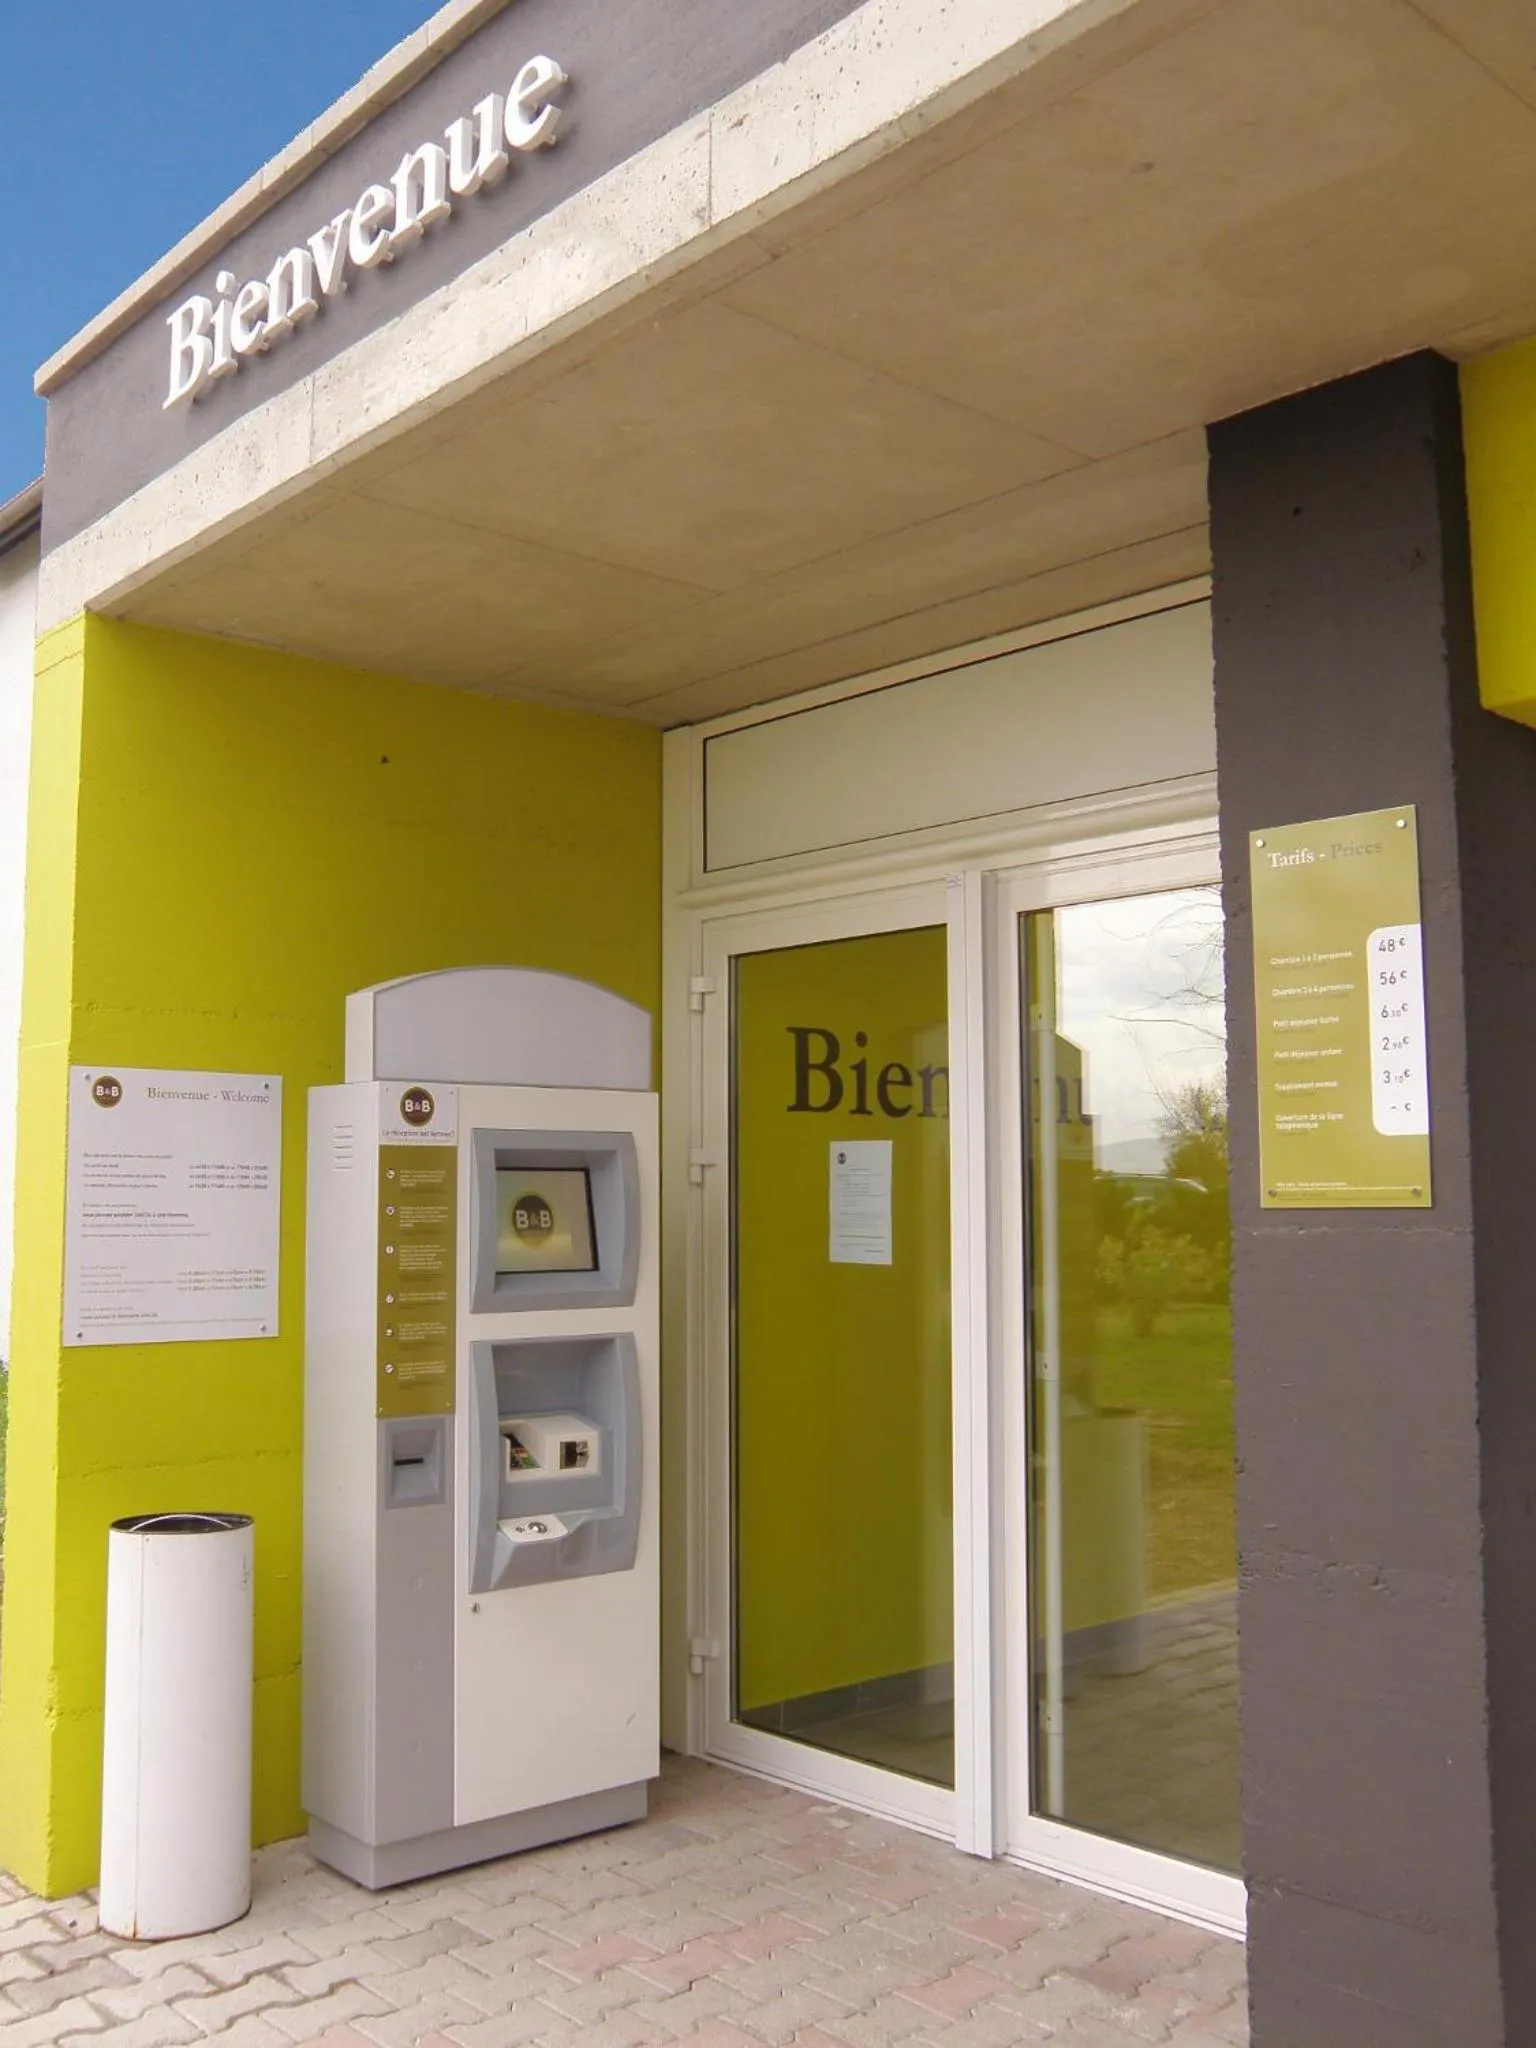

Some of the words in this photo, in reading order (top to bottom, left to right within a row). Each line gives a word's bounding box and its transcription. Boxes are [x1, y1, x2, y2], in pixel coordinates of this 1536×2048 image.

[163, 54, 569, 410] Bienvenue
[1268, 848, 1315, 868] Tarifs
[1330, 841, 1383, 859] Prices
[96, 1085, 120, 1097] B&B
[148, 1087, 210, 1101] Bienvenue
[221, 1090, 269, 1103] Welcome
[404, 1099, 431, 1112] B&B
[515, 1210, 551, 1228] B&B
